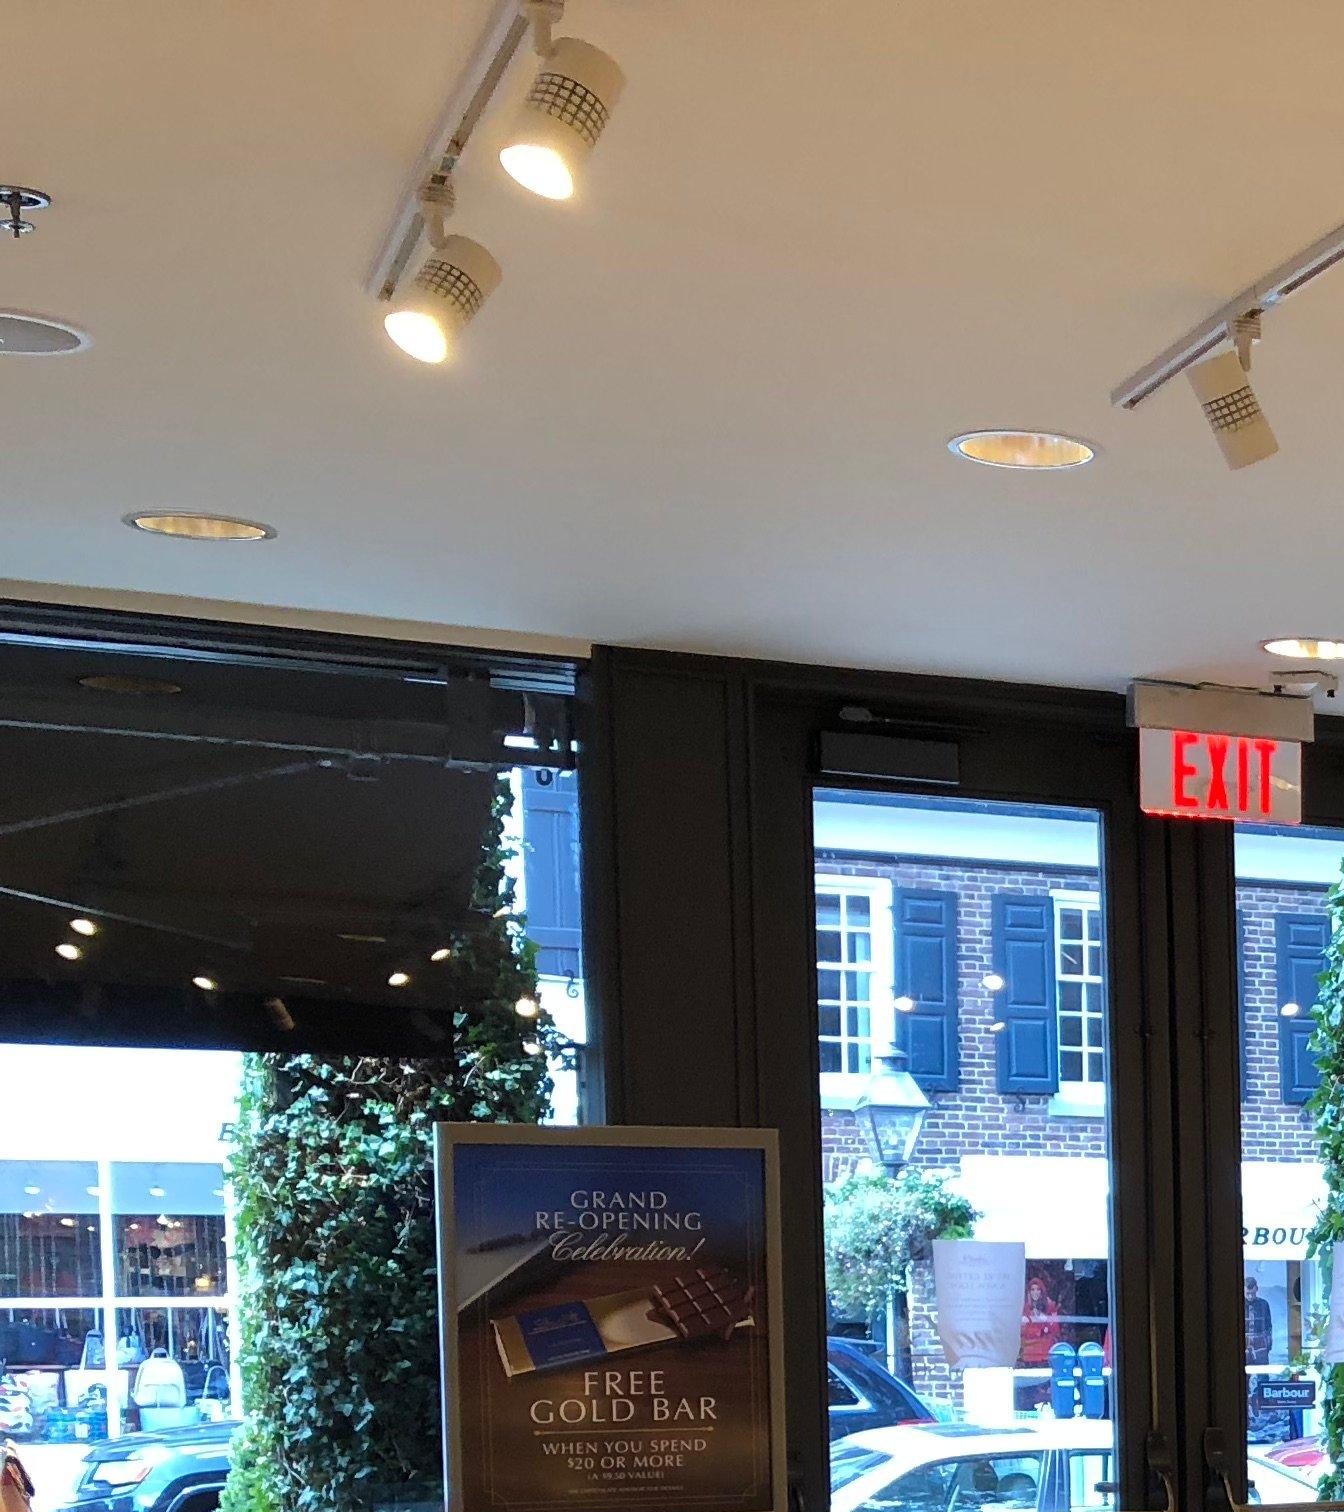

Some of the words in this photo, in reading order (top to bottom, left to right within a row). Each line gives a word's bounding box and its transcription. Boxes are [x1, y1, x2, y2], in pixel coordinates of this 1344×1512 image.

[1173, 731, 1277, 815] EXIT
[570, 1190, 668, 1210] GRAND
[535, 1211, 702, 1231] RE-OPENING
[549, 1230, 707, 1261] Celebration!
[584, 1370, 665, 1396] FREE
[1263, 1386, 1311, 1399] Barbour
[529, 1398, 636, 1425] GOLD
[653, 1396, 718, 1422] BAR
[542, 1442, 599, 1456] WHEN
[603, 1440, 643, 1454] YOU
[650, 1438, 708, 1452] SPEND
[567, 1457, 595, 1470] $20
[600, 1455, 627, 1469] OR
[633, 1454, 685, 1468] MORE
